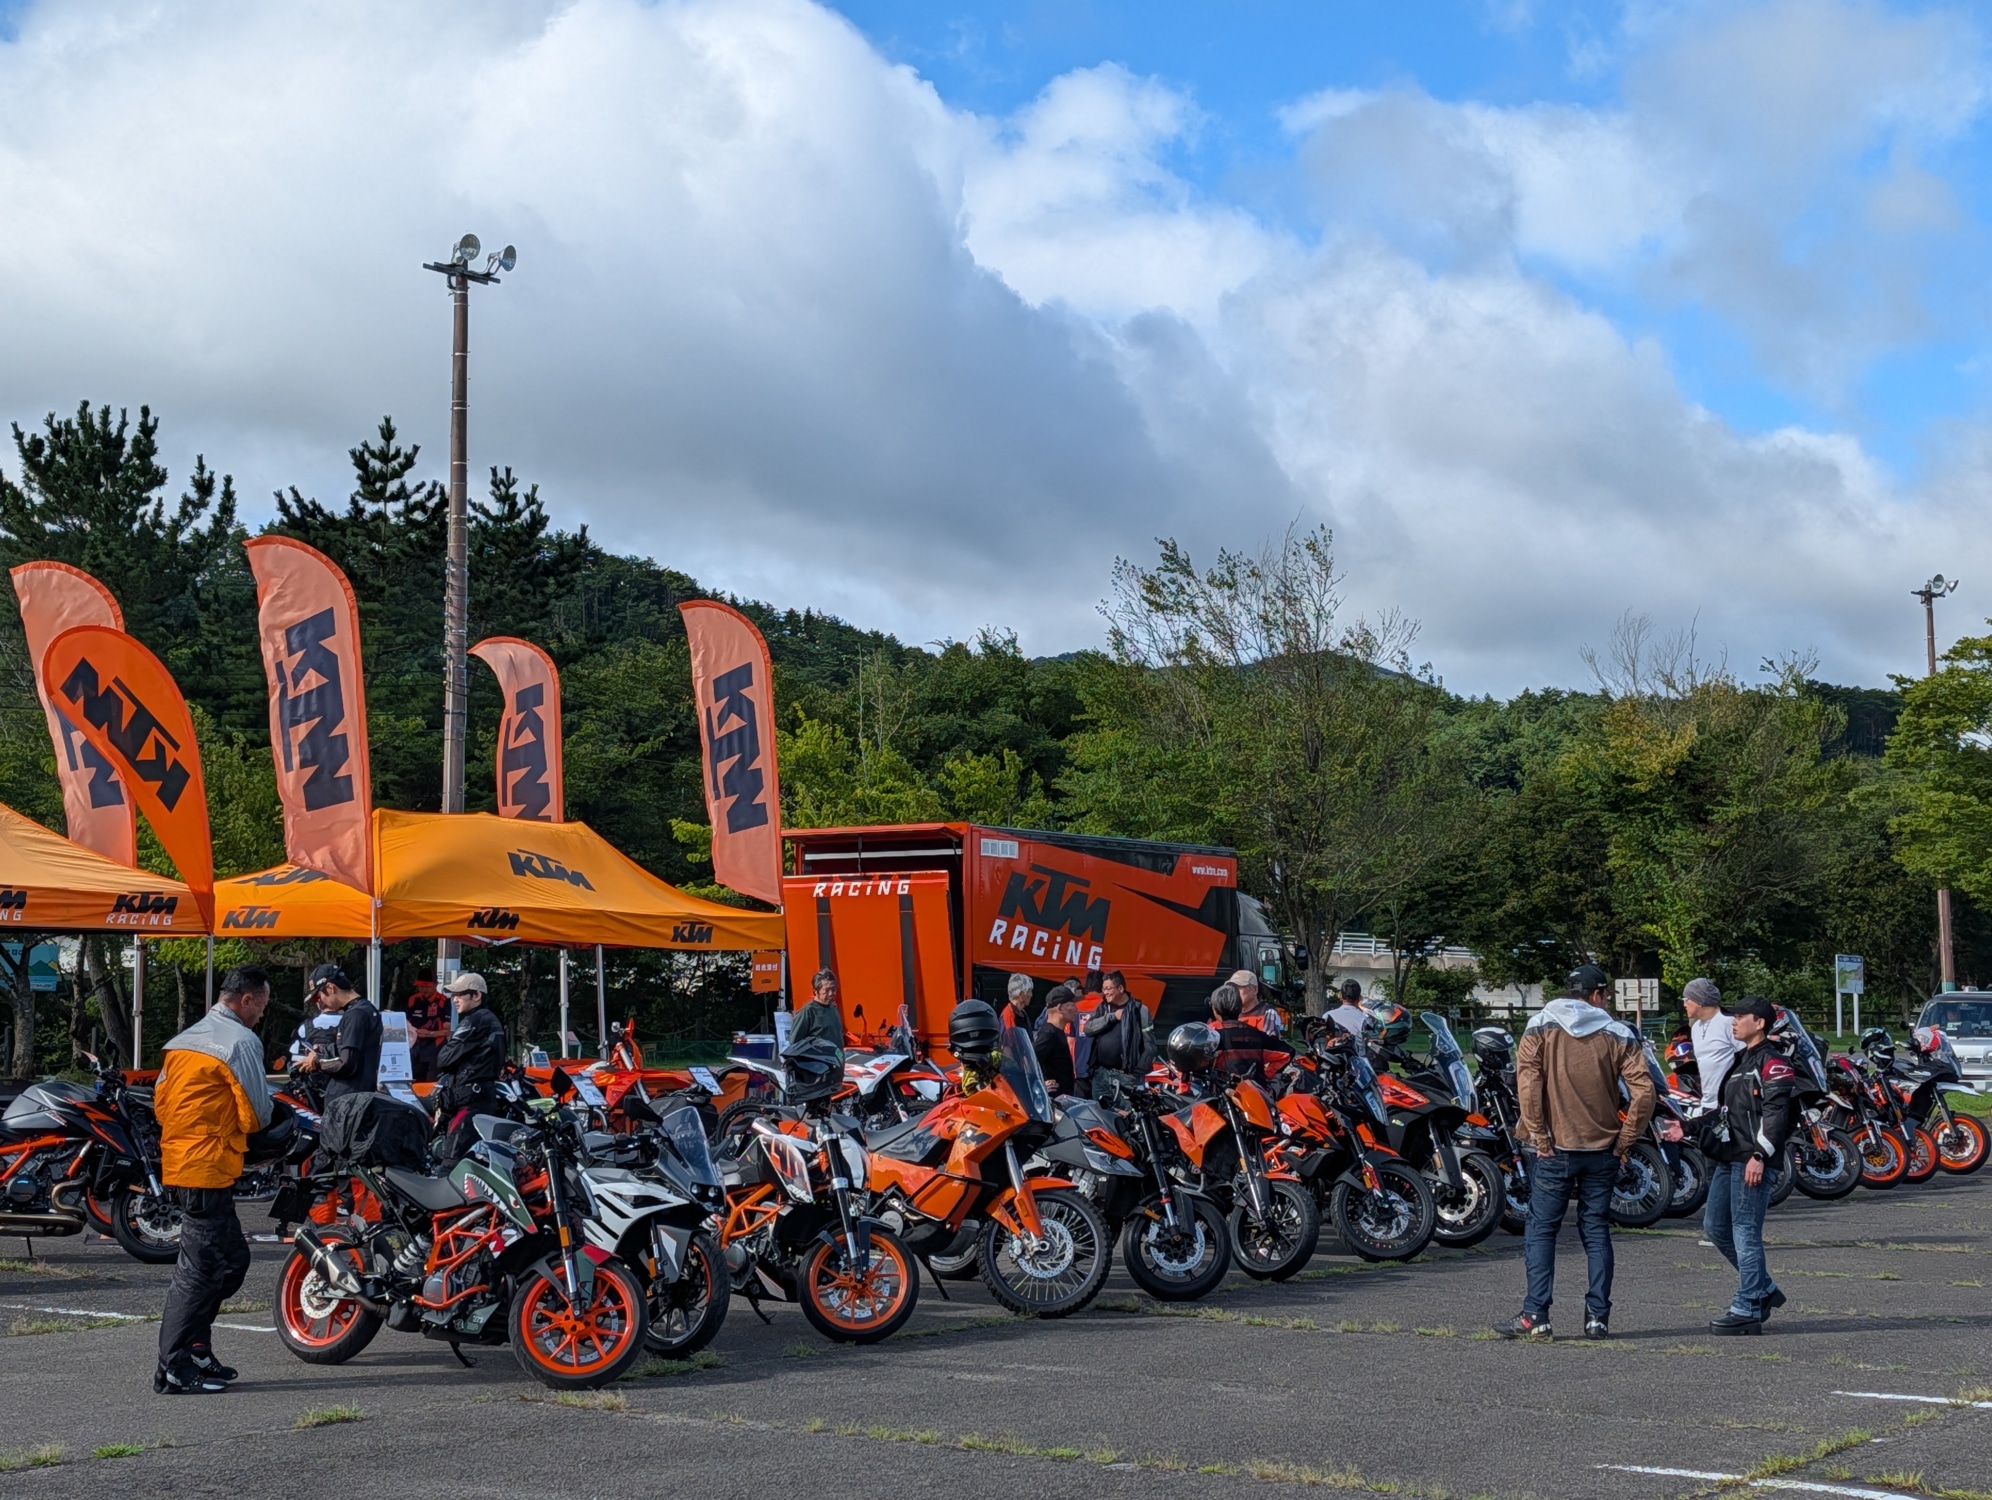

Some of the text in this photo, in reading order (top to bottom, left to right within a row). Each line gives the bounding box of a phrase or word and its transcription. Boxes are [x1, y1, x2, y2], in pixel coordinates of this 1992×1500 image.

[507, 848, 597, 892] KTM
[112, 891, 178, 914] KTM
[998, 863, 1111, 944] KTM
[222, 905, 282, 929] KTM
[466, 907, 520, 930] KTM
[671, 920, 713, 944] KTM
